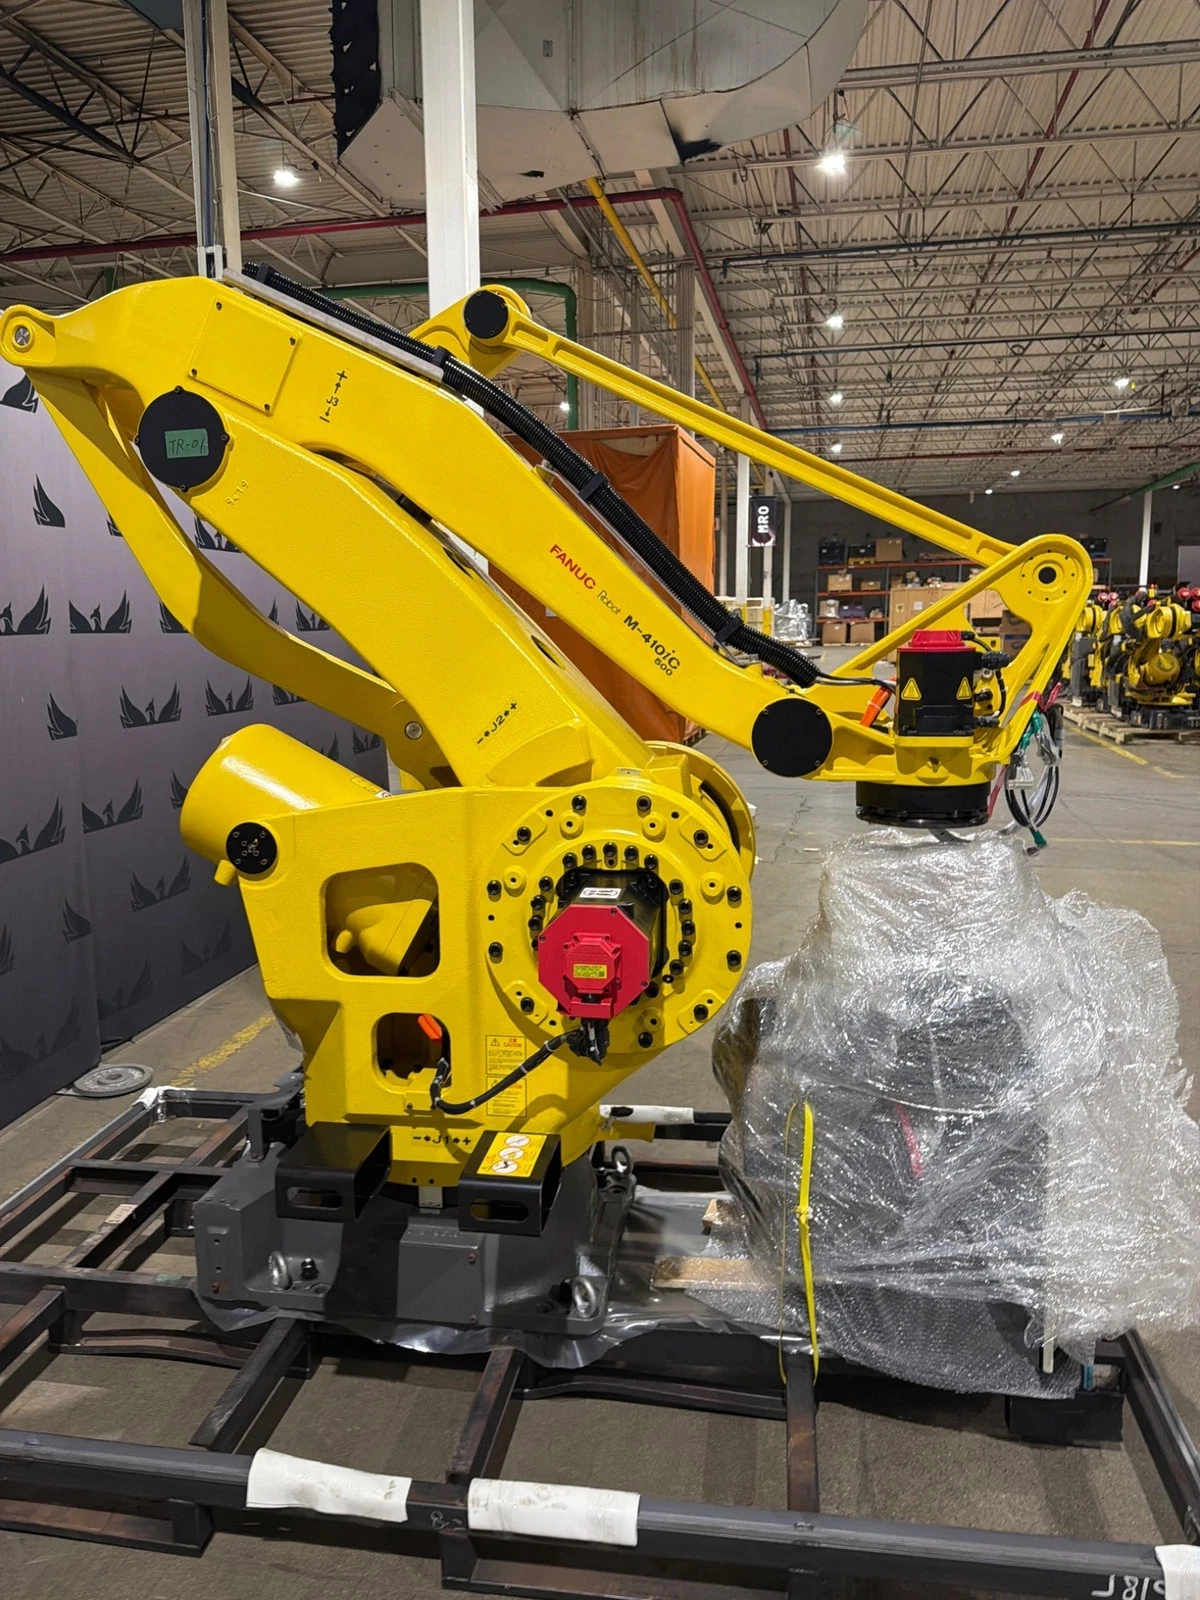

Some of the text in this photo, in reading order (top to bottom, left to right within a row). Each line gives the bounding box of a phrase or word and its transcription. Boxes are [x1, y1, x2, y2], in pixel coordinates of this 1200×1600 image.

[326, 396, 339, 407] J3
[168, 437, 205, 455] TR-01
[549, 544, 681, 670] FANUC Robot M-410iC
[491, 714, 505, 732] J2
[432, 1135, 449, 1144] J1
